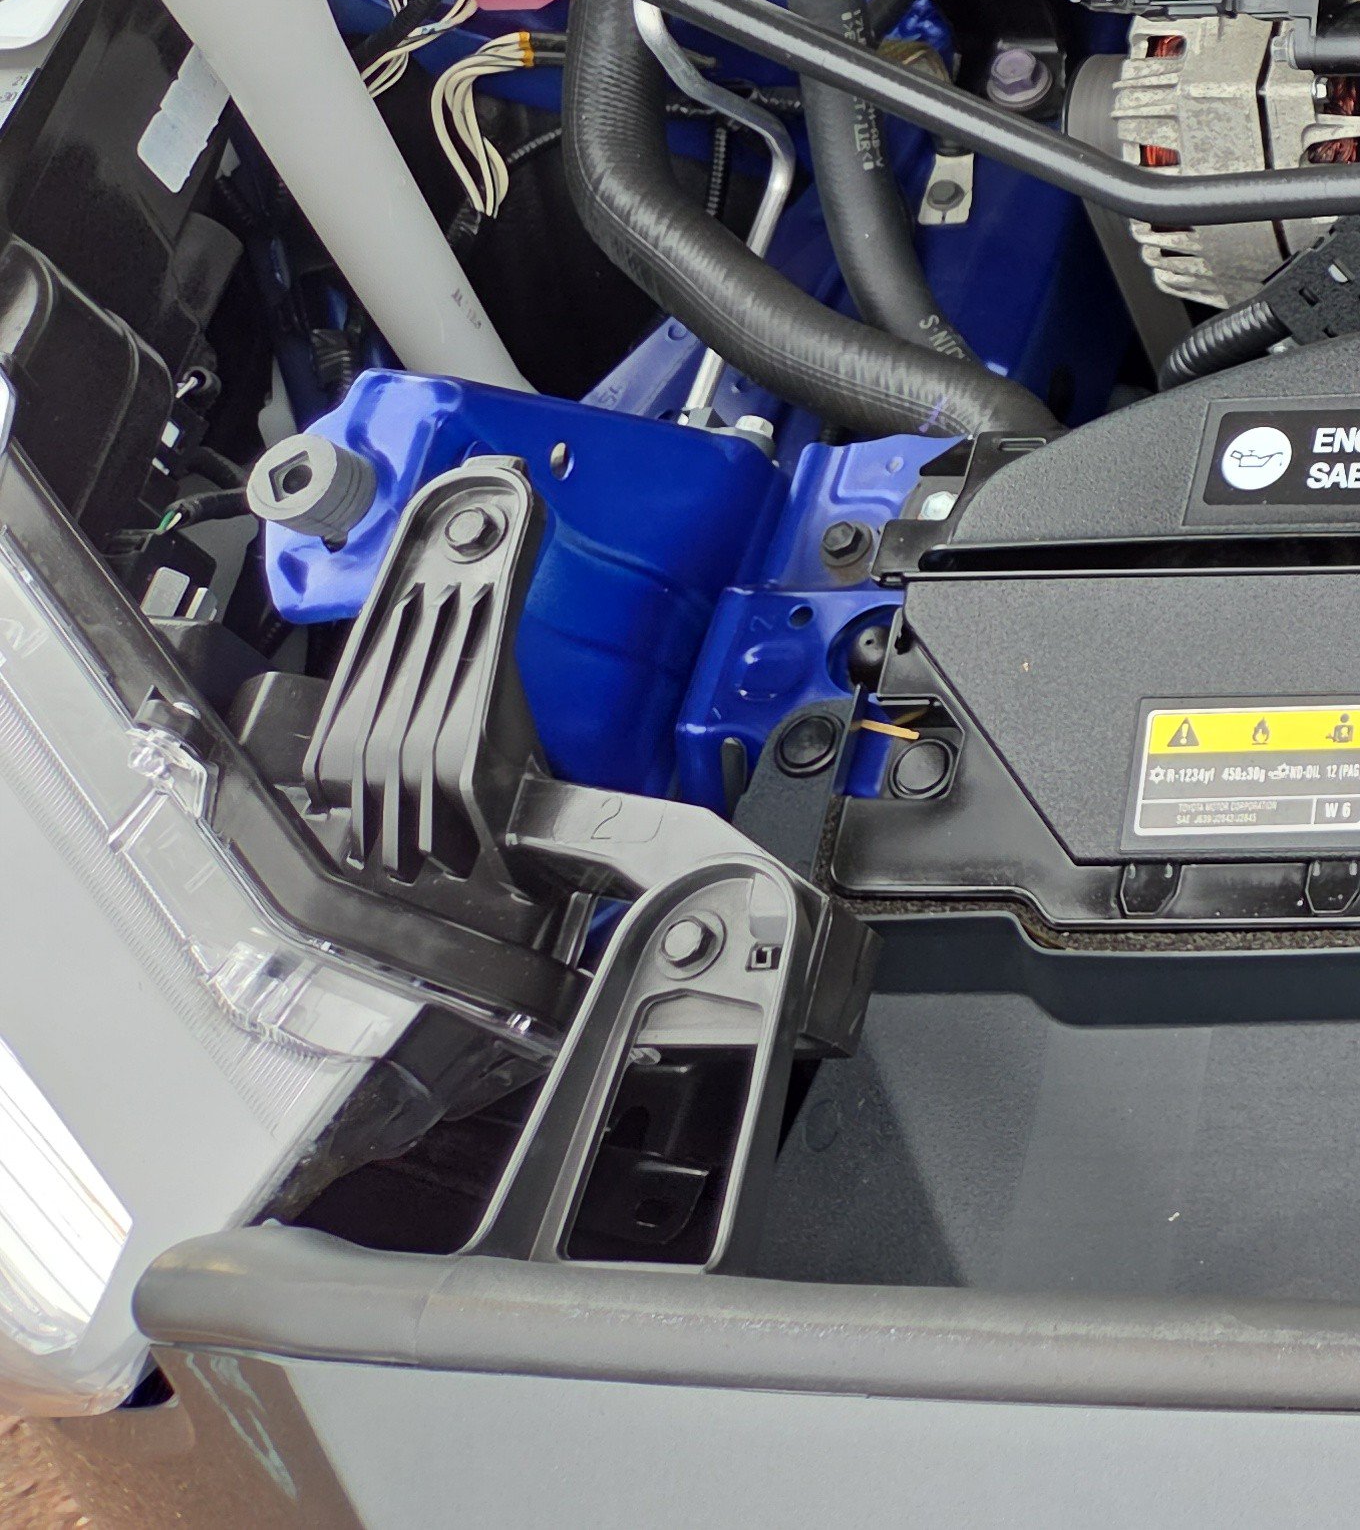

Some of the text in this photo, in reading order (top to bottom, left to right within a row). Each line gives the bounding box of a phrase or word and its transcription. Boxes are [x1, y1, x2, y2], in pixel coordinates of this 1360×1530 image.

[1166, 766, 1216, 785] R-1234yf
[1325, 801, 1352, 818] W 6
